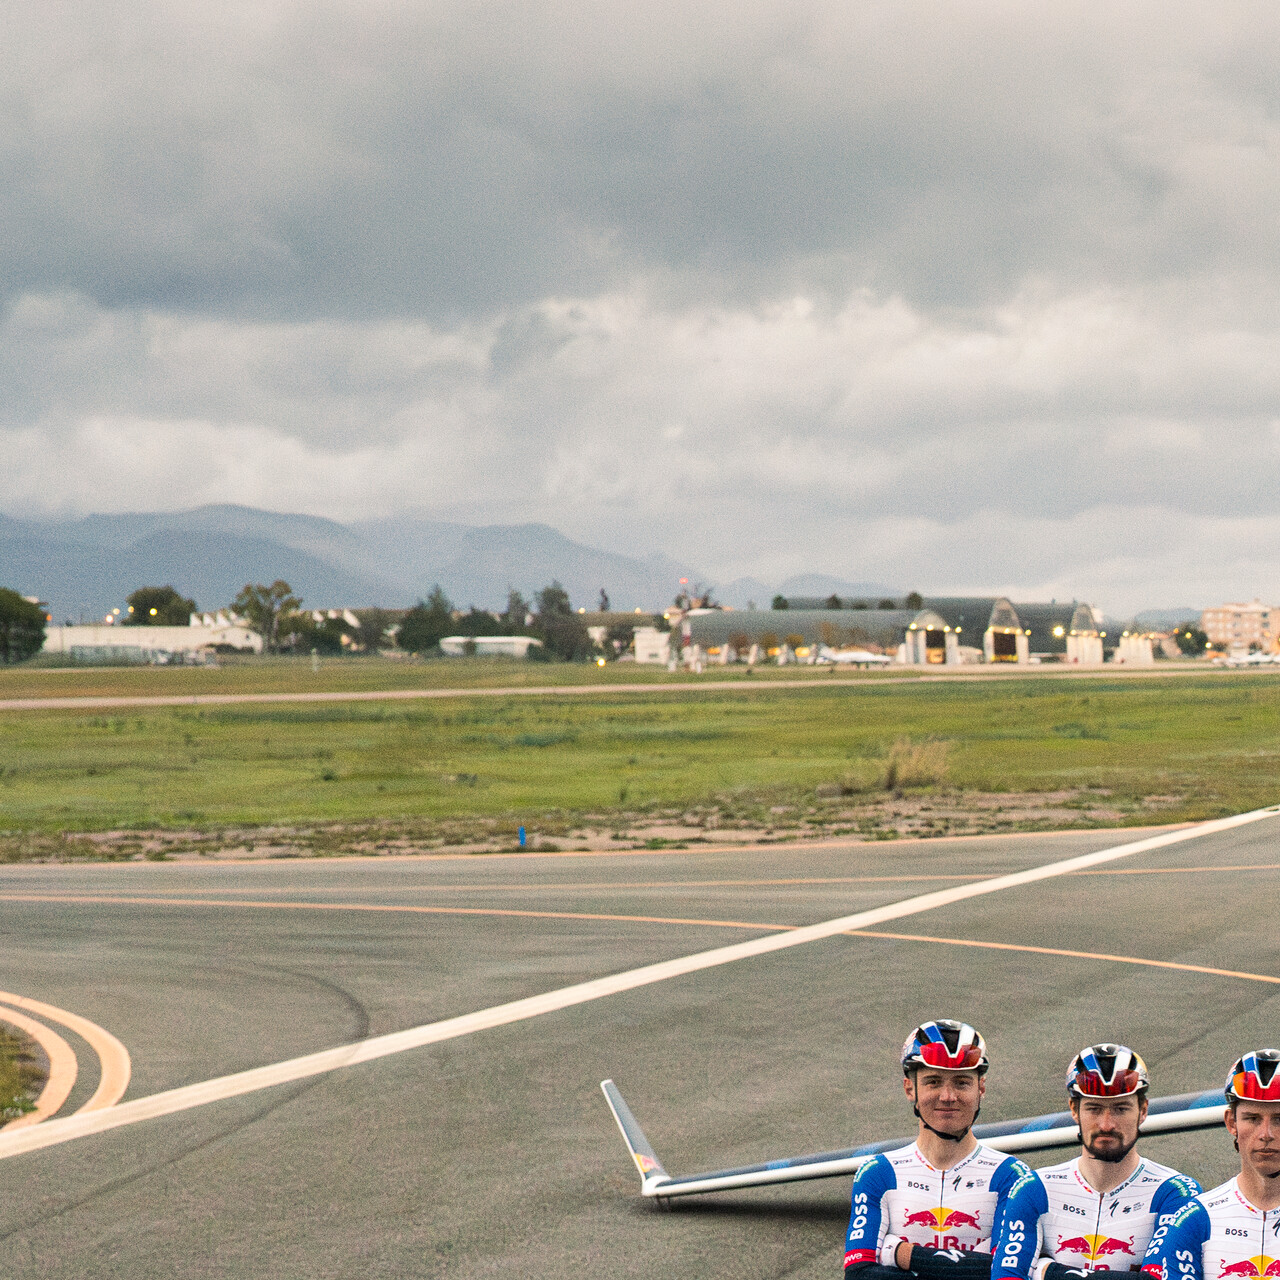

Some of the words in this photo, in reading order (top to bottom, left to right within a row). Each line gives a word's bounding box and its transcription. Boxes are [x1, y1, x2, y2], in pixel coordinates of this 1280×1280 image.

[908, 1181, 930, 1192] BOSS
[849, 1192, 868, 1241] BOSS
[1062, 1203, 1086, 1216] BOSS
[1000, 1219, 1025, 1268] BOSS
[1145, 1213, 1172, 1258] BOSS
[1225, 1228, 1248, 1238] BOSS
